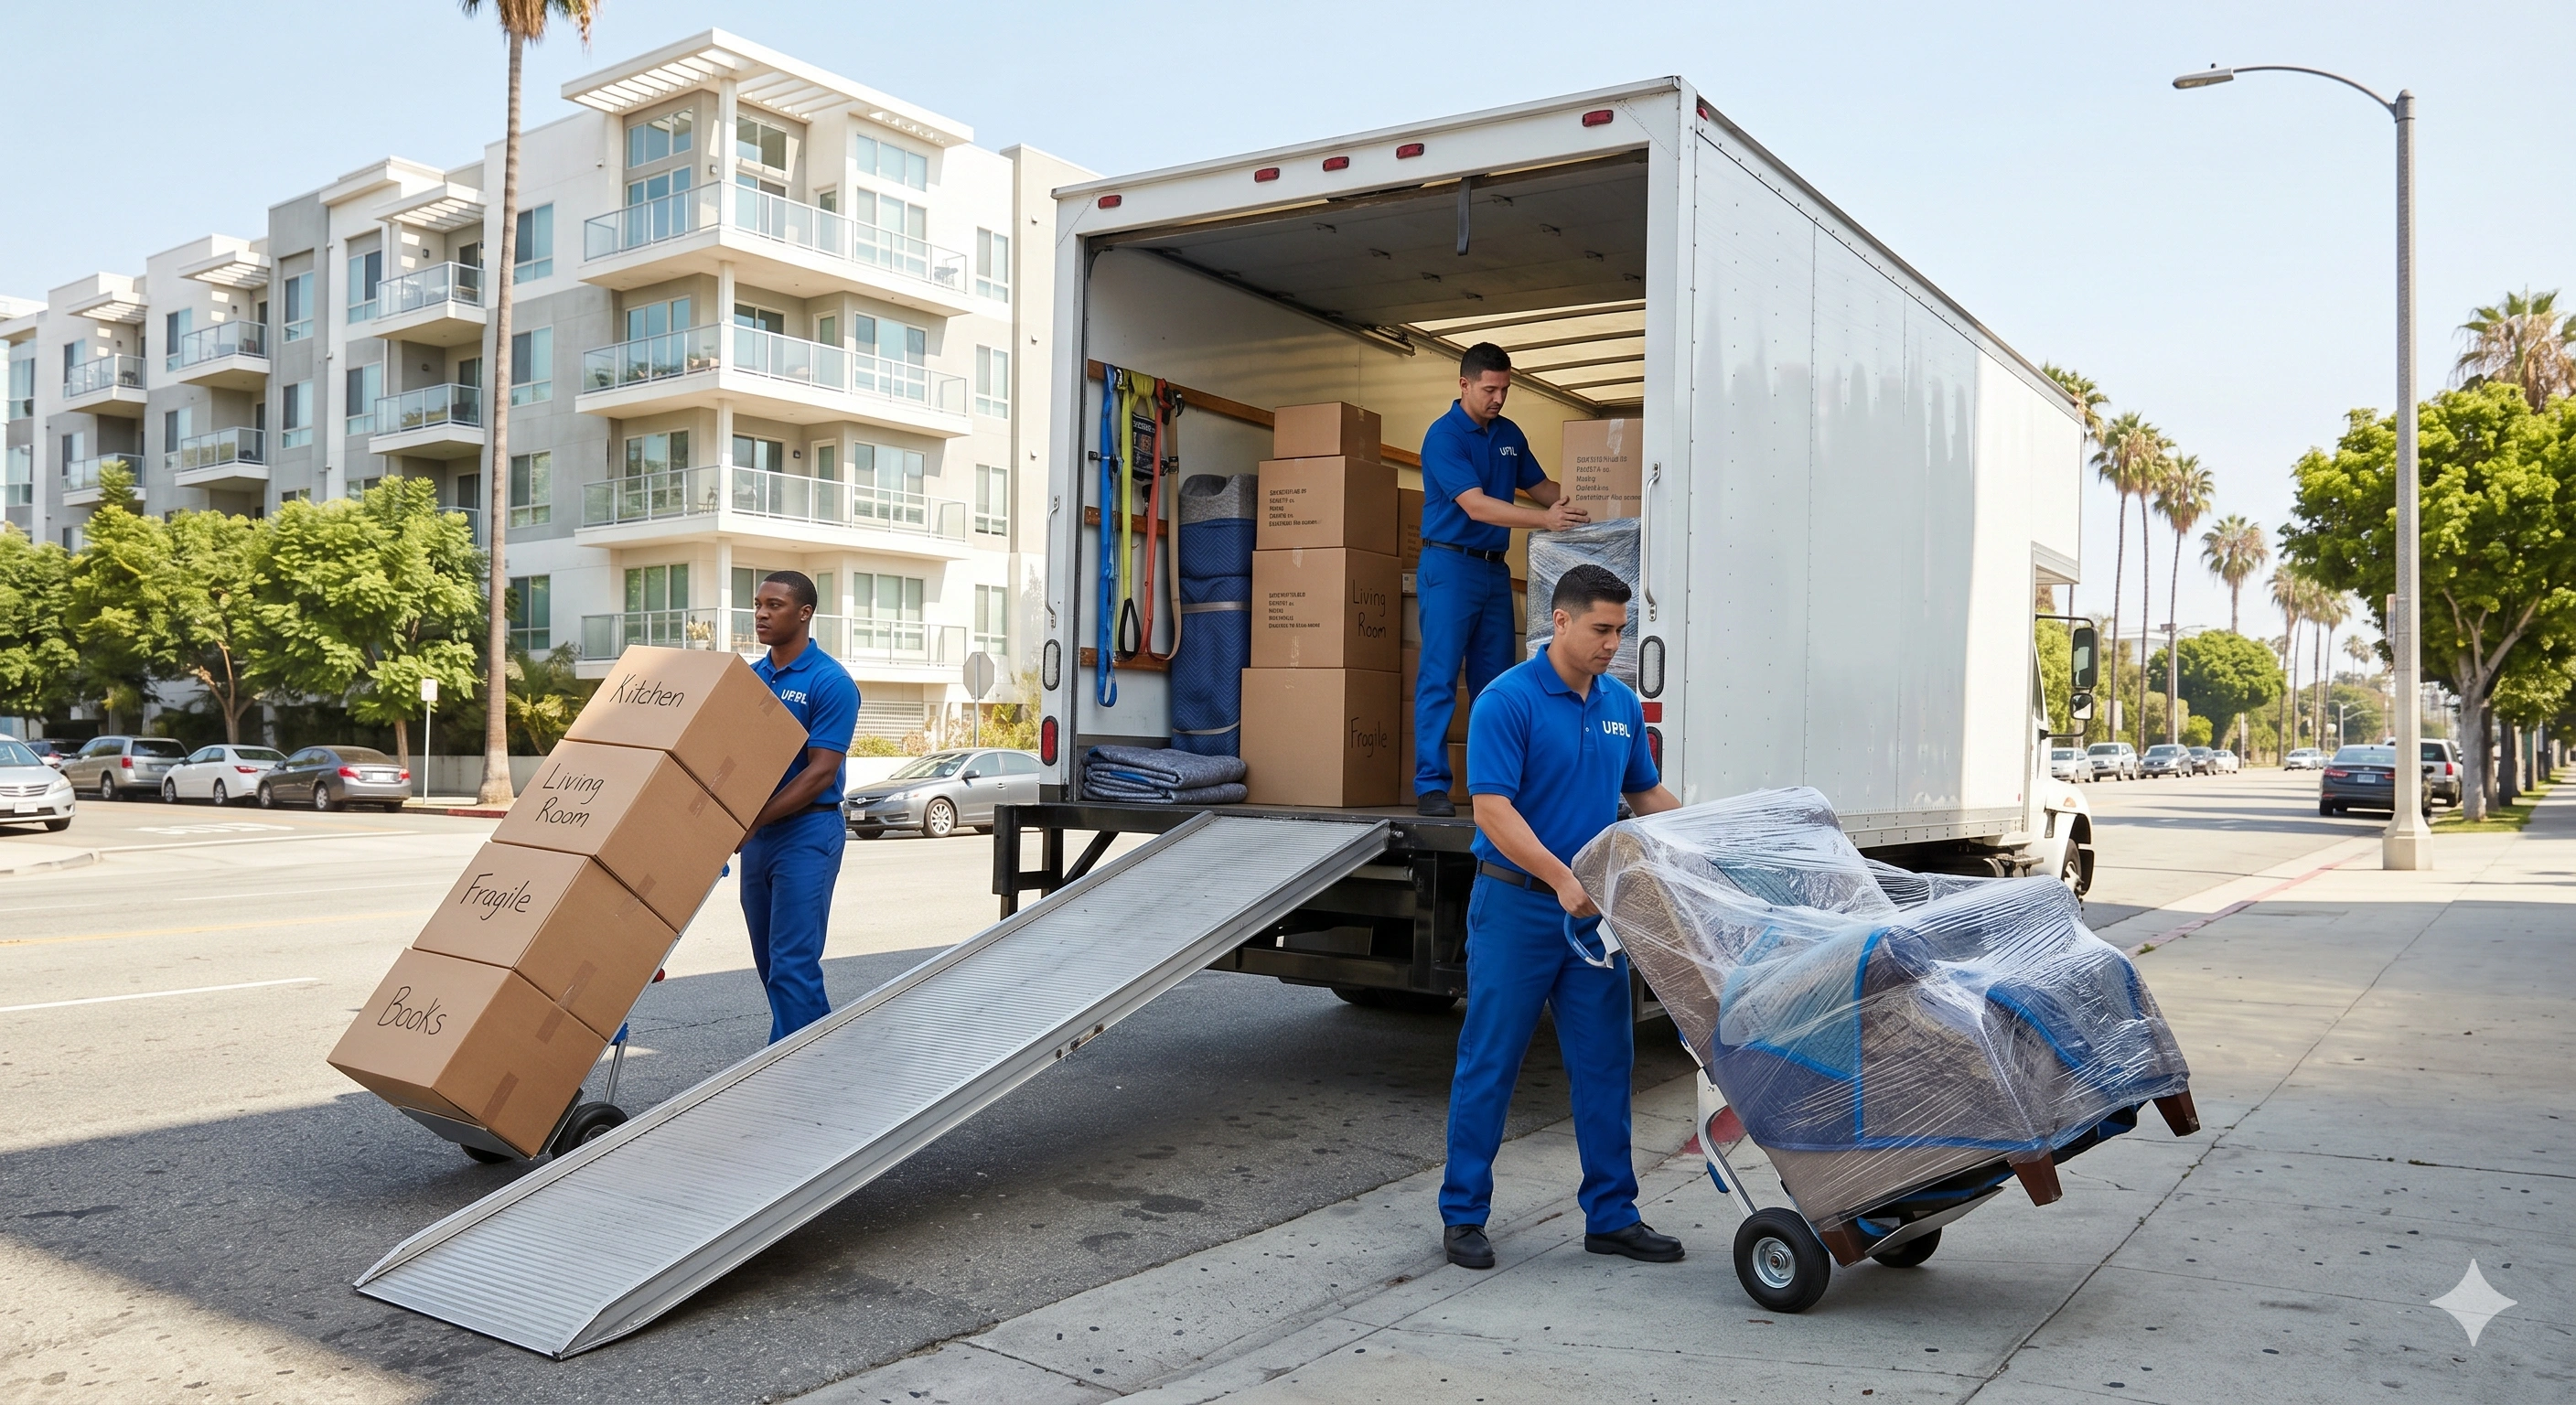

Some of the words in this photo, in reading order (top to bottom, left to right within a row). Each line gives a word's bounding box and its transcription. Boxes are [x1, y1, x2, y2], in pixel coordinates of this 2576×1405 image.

[1353, 579, 1386, 617] Living
[1358, 612, 1387, 638] Room
[609, 673, 685, 708] Kitchen
[1351, 716, 1388, 758] Fragile
[542, 763, 605, 805] Living
[535, 796, 590, 828] Room
[460, 873, 531, 921] Fragile
[377, 985, 447, 1035] Books
